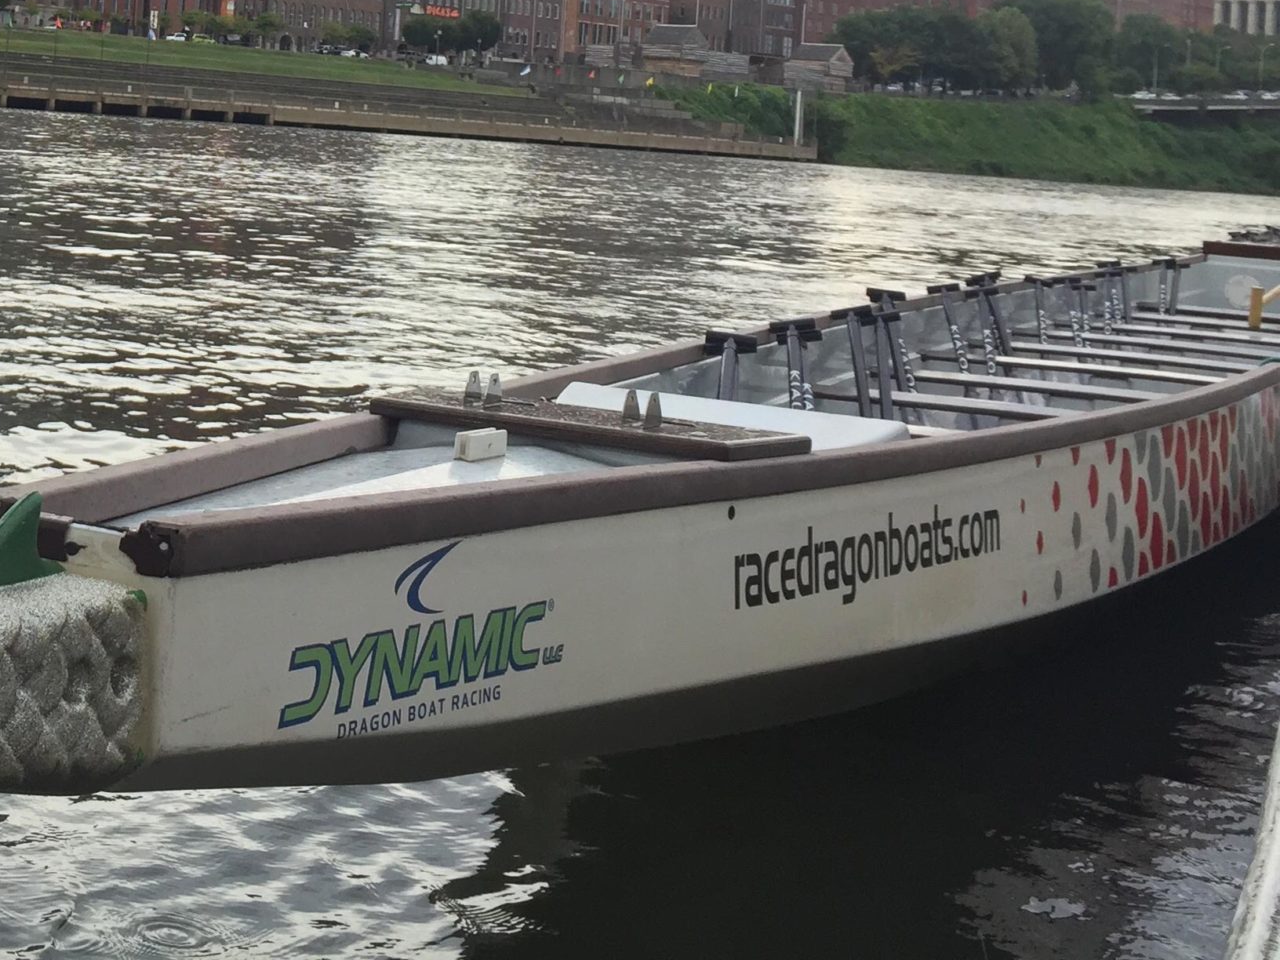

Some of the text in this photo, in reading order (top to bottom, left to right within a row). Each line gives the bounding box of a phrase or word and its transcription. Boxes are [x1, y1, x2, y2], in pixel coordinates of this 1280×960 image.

[734, 503, 1001, 610] racedragonboats.com
[277, 599, 548, 730] DYNAMIC
[542, 642, 565, 665] LLC
[336, 685, 502, 740] DRAGON BOAT RACING
